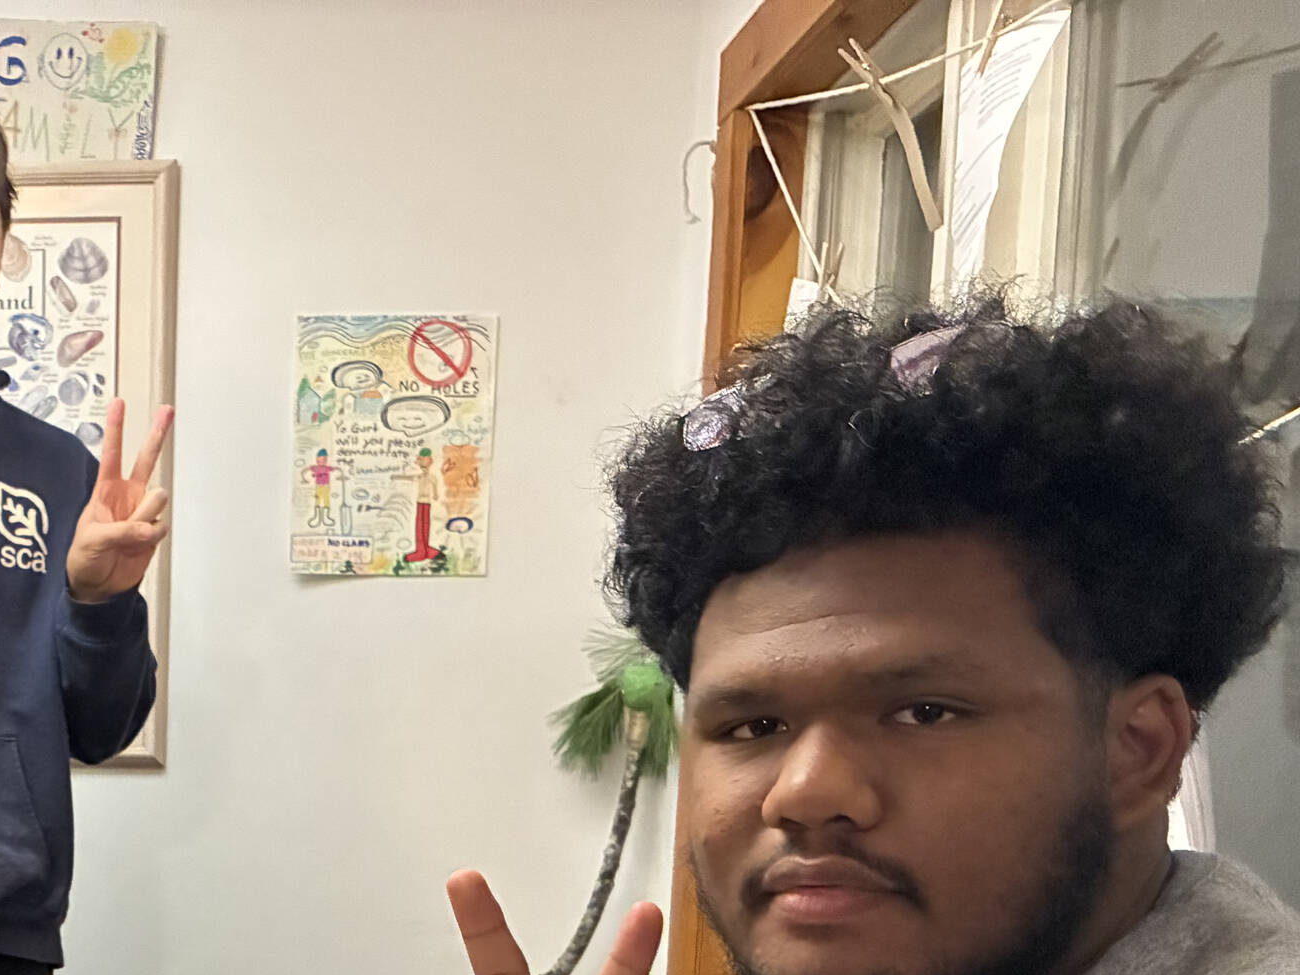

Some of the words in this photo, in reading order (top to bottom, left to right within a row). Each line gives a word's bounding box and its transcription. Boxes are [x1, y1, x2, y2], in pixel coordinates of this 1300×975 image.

[399, 380, 420, 393] NO
[431, 380, 480, 395] HOLES
[363, 438, 384, 449] you
[0, 545, 47, 574] sca
